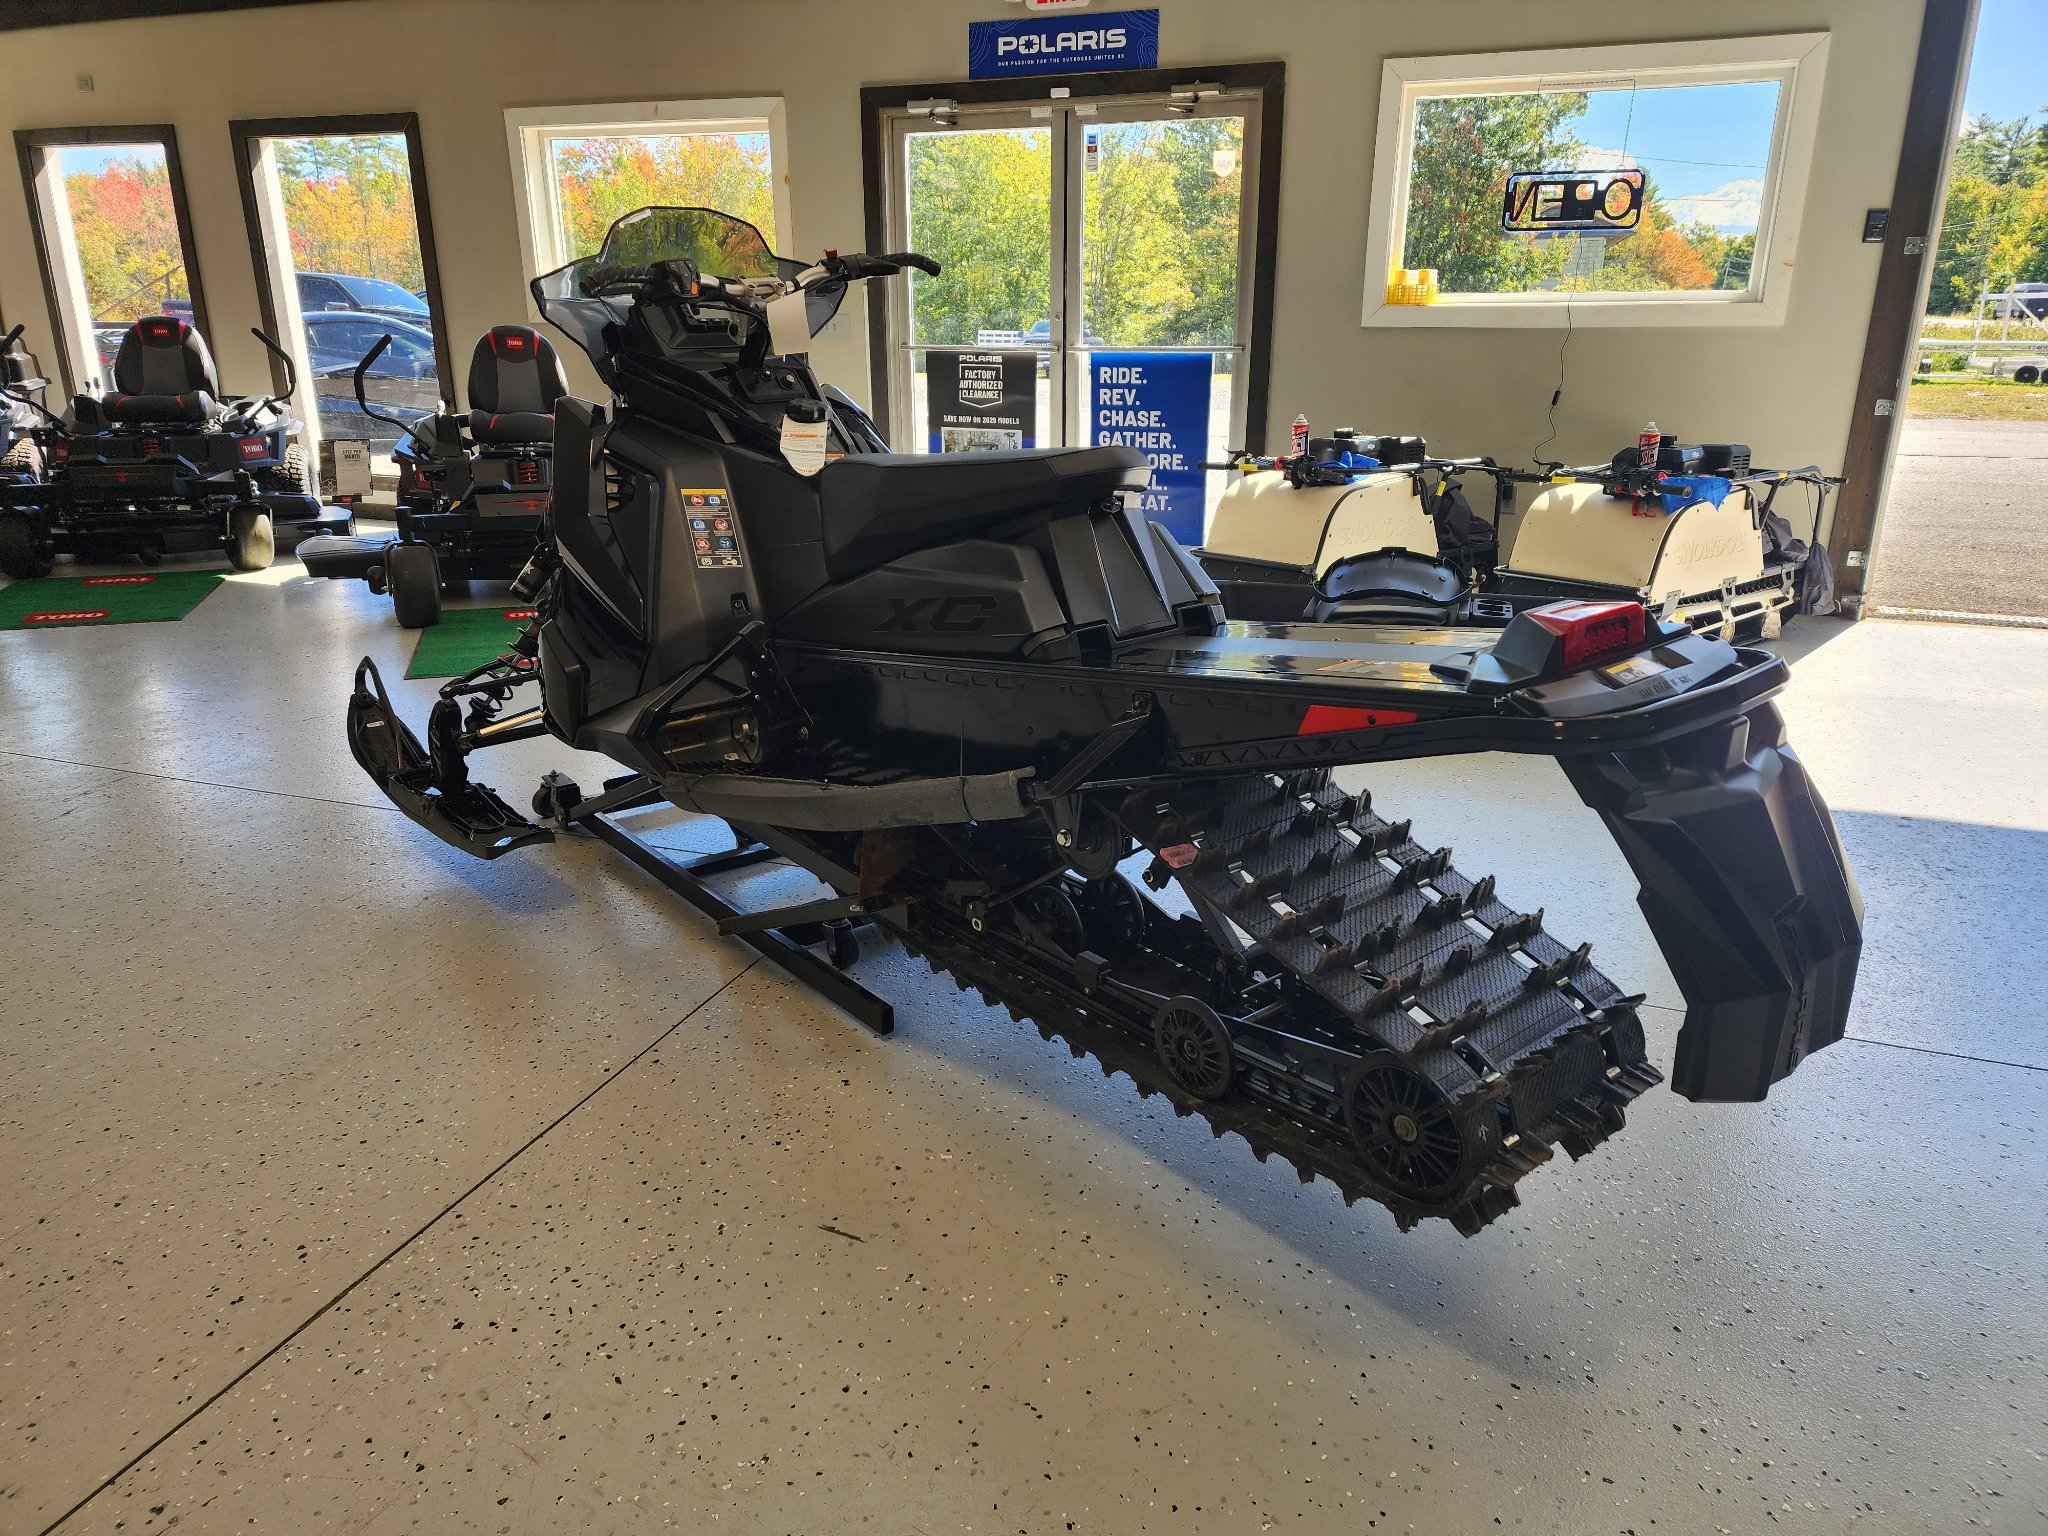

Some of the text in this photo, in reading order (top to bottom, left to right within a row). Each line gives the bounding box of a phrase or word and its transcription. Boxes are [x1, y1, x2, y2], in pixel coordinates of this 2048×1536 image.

[998, 28, 1127, 56] POLARIS
[1062, 55, 1092, 63] OUTDOORS
[959, 354, 1003, 363] POLARIS
[964, 369, 997, 380] FACTORY
[1100, 366, 1148, 385] RIDE.
[959, 380, 1003, 390] AUTHORIZED
[962, 389, 999, 399] CLEARANCE
[1099, 388, 1141, 406] REV.
[943, 414, 958, 423] SAVE
[958, 415, 972, 423] NOW
[973, 416, 981, 424] ON
[998, 417, 1020, 425] MODELS
[1099, 409, 1166, 428] CHASE.
[1099, 430, 1177, 449] GATHER.
[242, 444, 263, 453] TORO
[34, 612, 104, 620] TORO
[871, 595, 999, 632] XC
